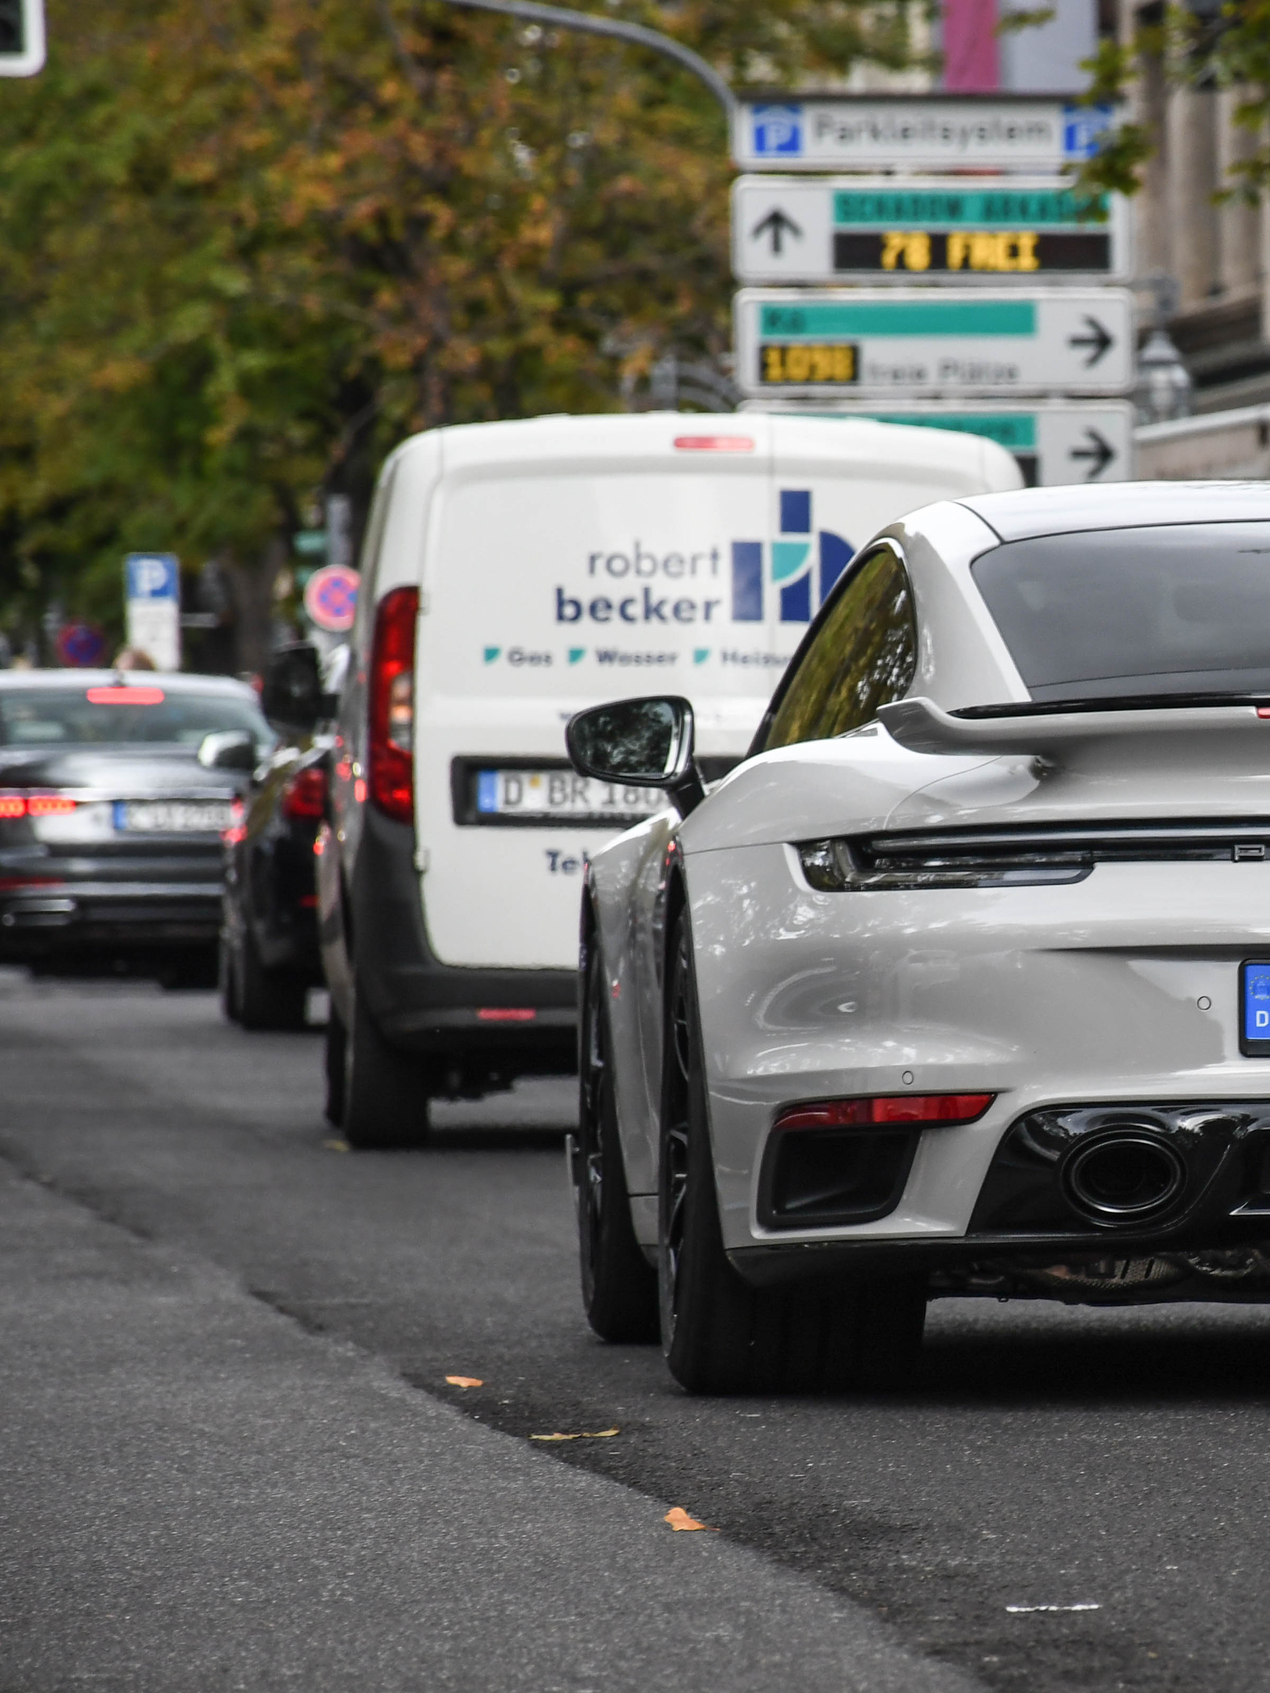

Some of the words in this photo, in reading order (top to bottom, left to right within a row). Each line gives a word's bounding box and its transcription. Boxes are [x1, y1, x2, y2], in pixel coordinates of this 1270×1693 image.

[813, 114, 1051, 149] Parkleitsystem
[588, 541, 719, 577] robert
[556, 587, 721, 623] becker
[507, 648, 552, 667] Gas
[595, 648, 678, 667] Wasser
[504, 774, 523, 805] D
[550, 774, 590, 806] BR
[1255, 1010, 1269, 1028] D
